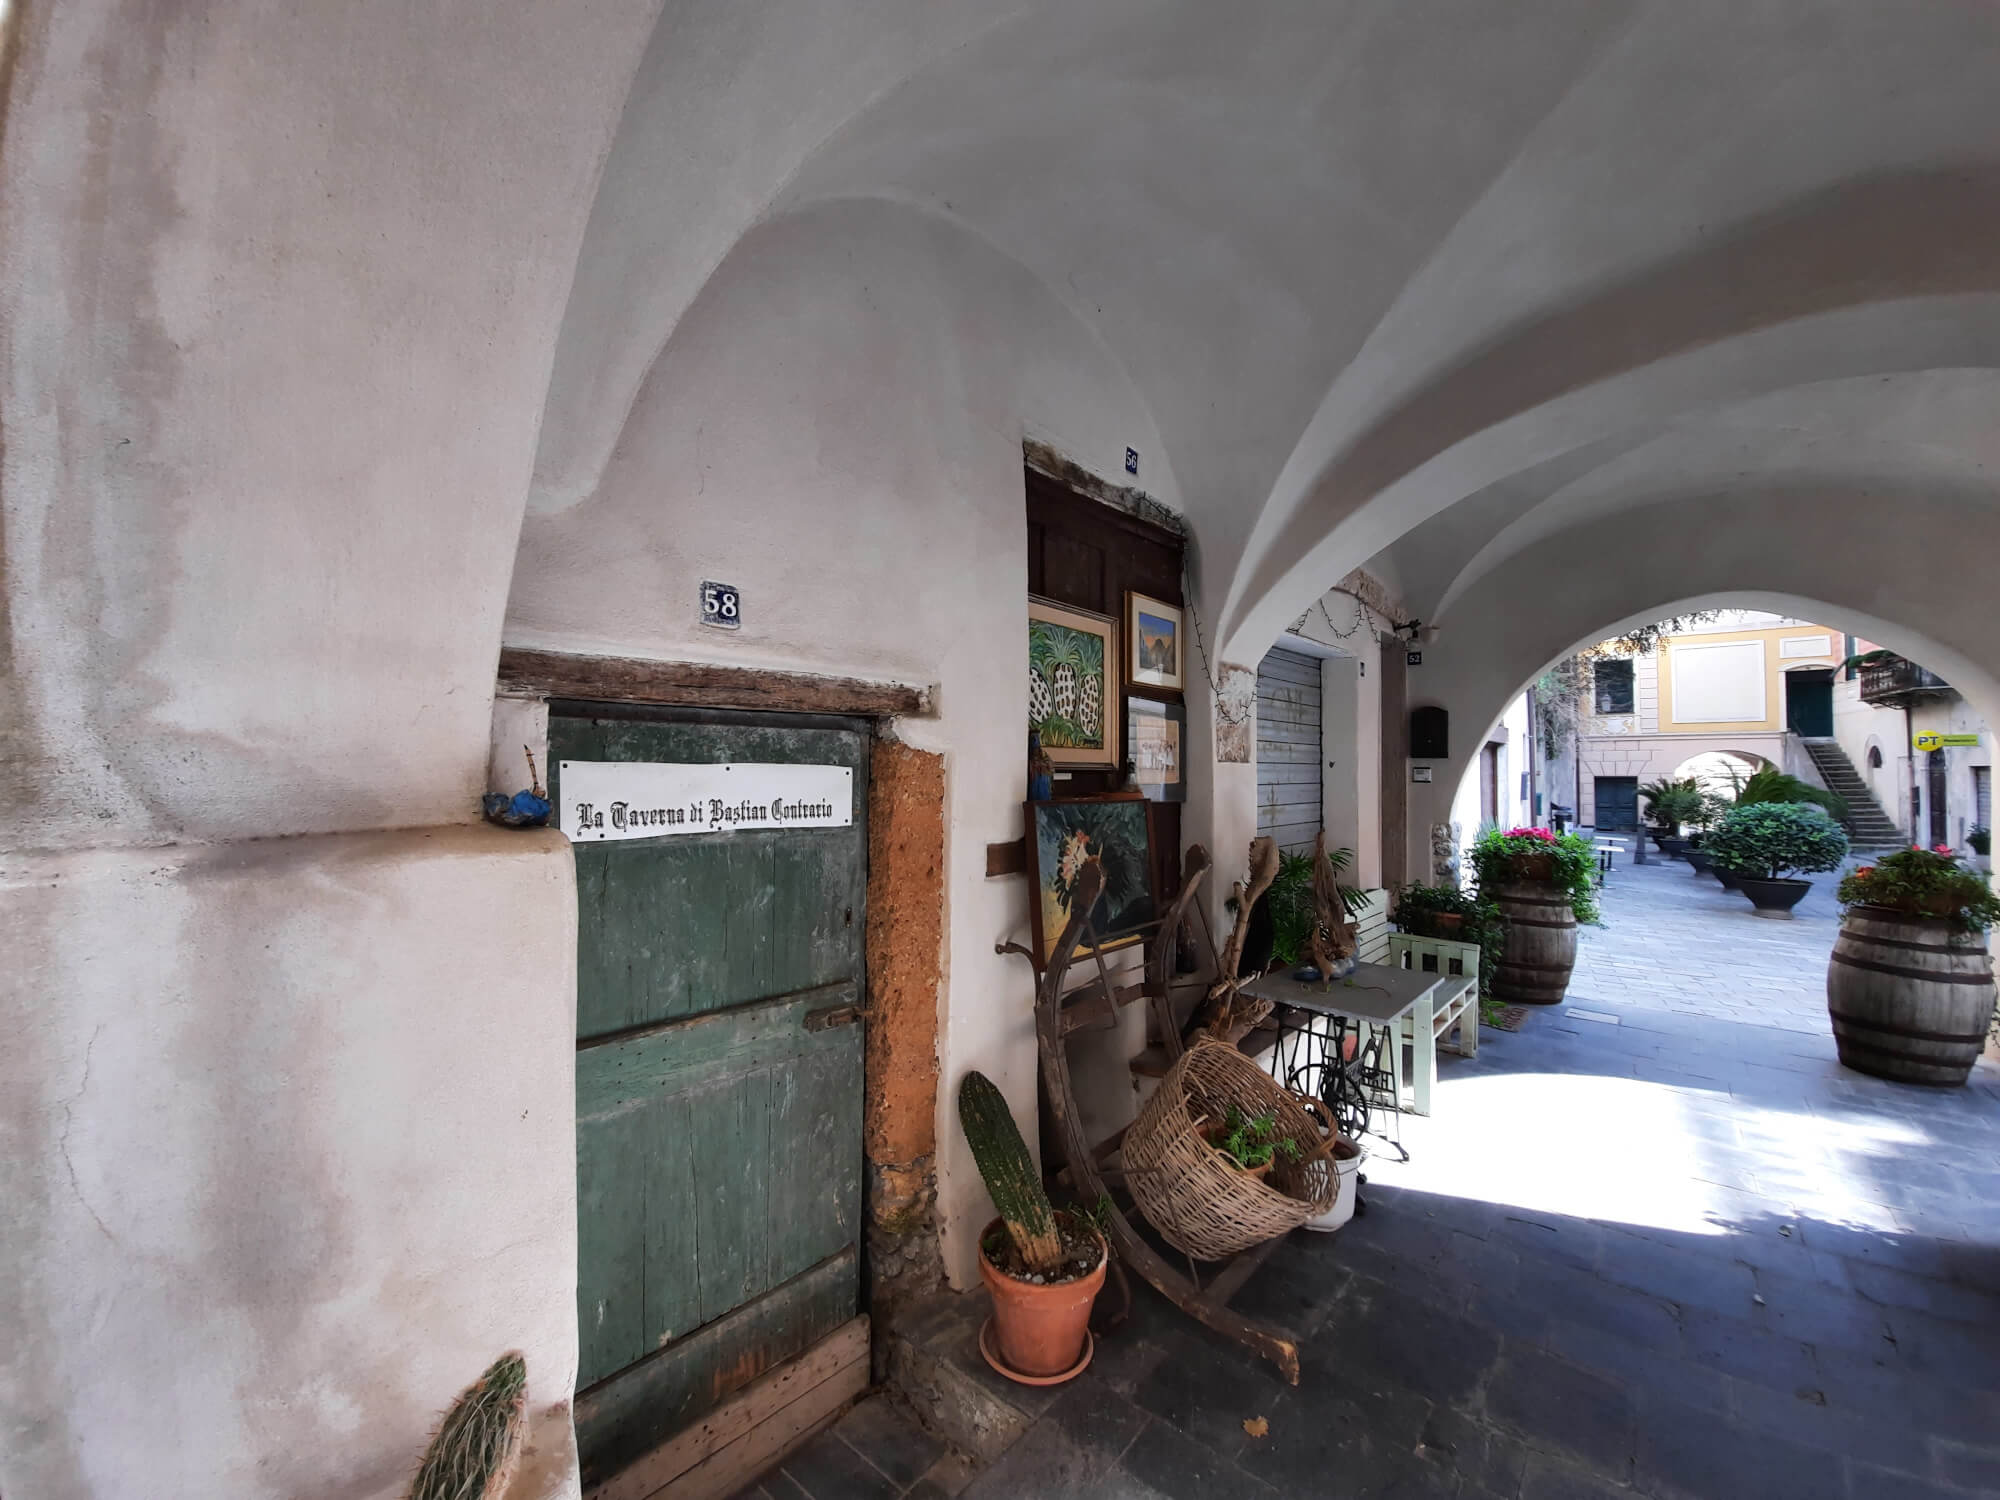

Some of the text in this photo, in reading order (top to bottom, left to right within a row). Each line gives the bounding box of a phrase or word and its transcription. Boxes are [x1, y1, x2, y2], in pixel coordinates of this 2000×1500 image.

[1126, 451, 1137, 468] 56
[704, 589, 737, 617] 58
[1409, 654, 1420, 663] 52
[1918, 736, 1940, 746] PT
[576, 797, 833, 837] La Taverna di Bastian Contrario
